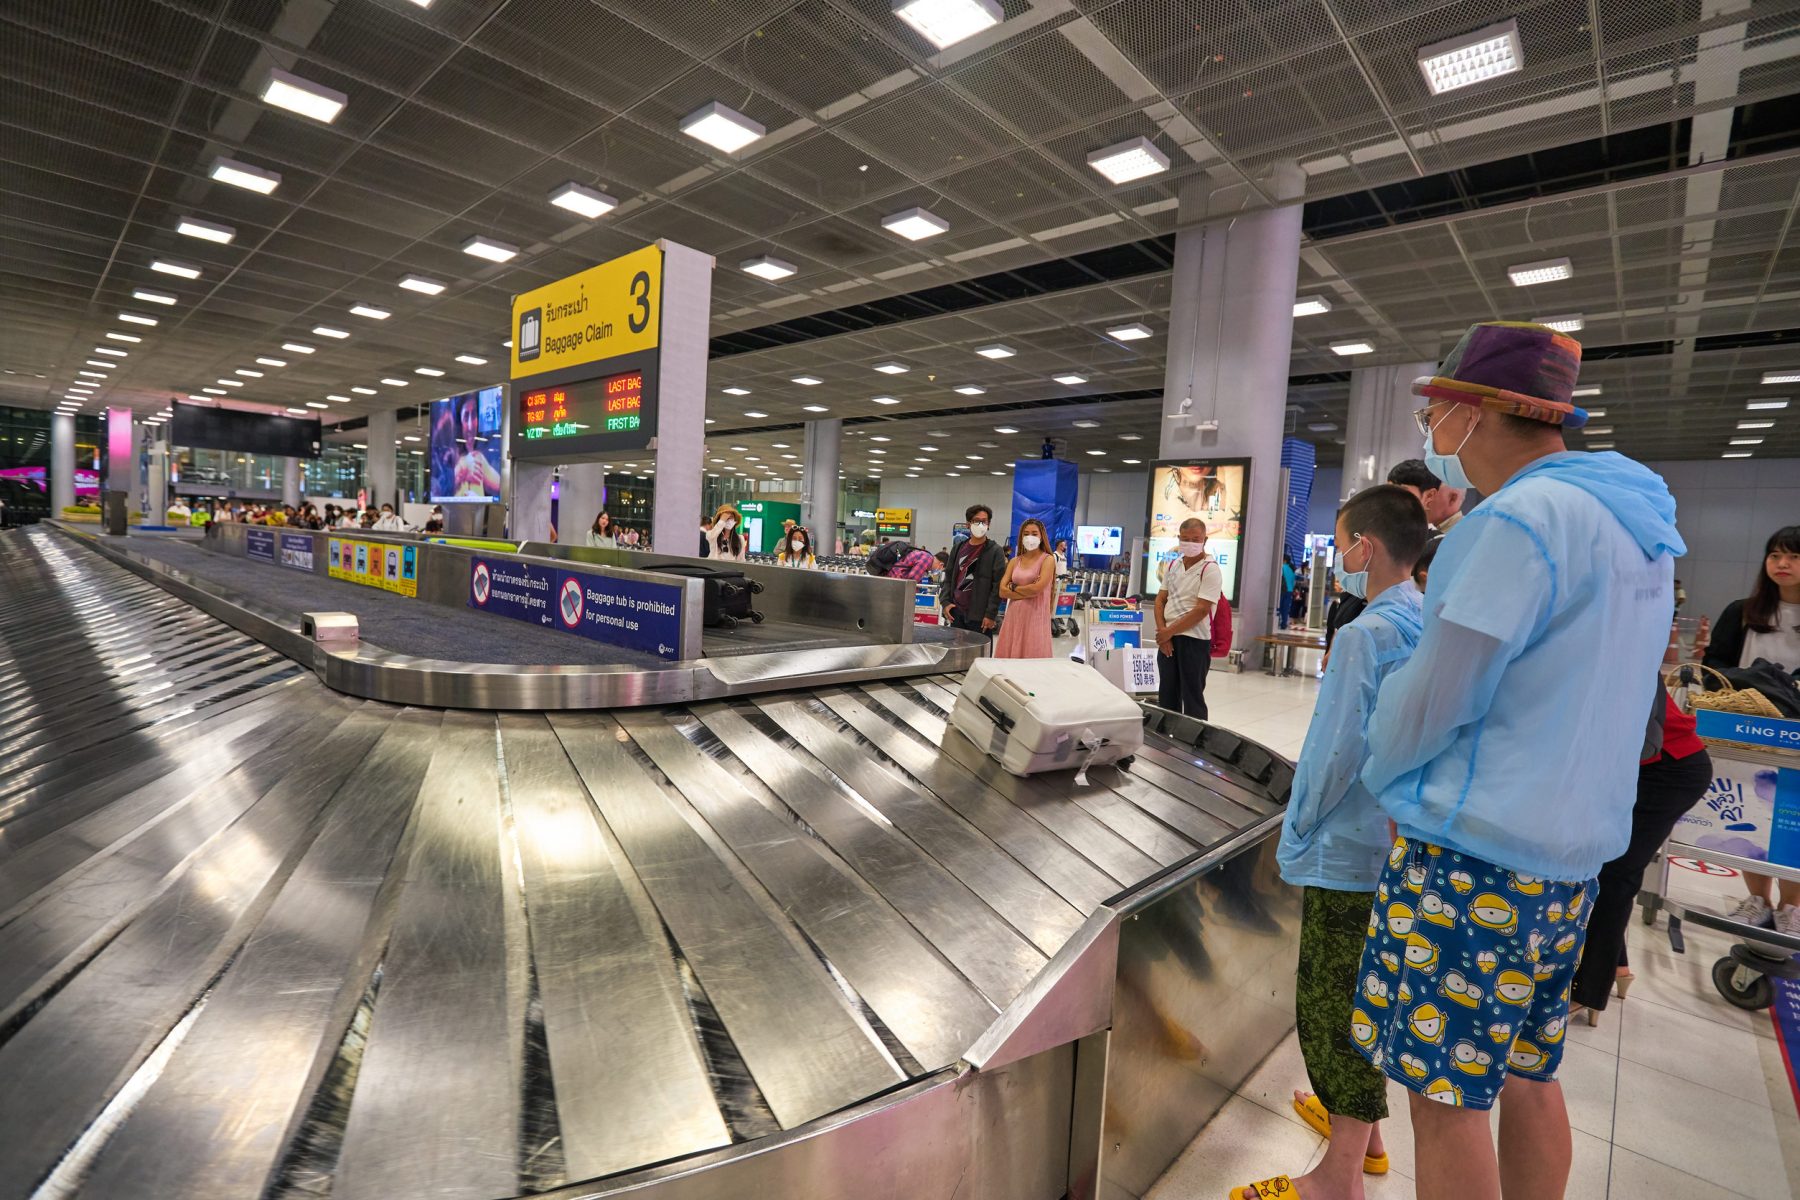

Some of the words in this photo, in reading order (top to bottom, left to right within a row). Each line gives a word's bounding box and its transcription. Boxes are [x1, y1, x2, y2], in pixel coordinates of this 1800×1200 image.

[628, 270, 650, 334] 3
[546, 331, 583, 354] Baggage
[586, 322, 612, 342] Claim
[609, 380, 626, 393] LAST
[628, 377, 641, 390] BAG
[608, 398, 626, 412] LAST
[627, 396, 640, 408] BAG
[608, 416, 628, 430] FIRST
[586, 589, 614, 607] Baggage
[616, 594, 628, 606] tub
[628, 596, 635, 608] is
[636, 598, 674, 616] prohibited
[586, 608, 594, 620] for
[596, 612, 625, 628] personal
[626, 620, 638, 631] use
[1133, 660, 1142, 672] 150
[1142, 660, 1154, 672] Baht
[1134, 673, 1143, 686] 150
[1736, 724, 1776, 737] KING
